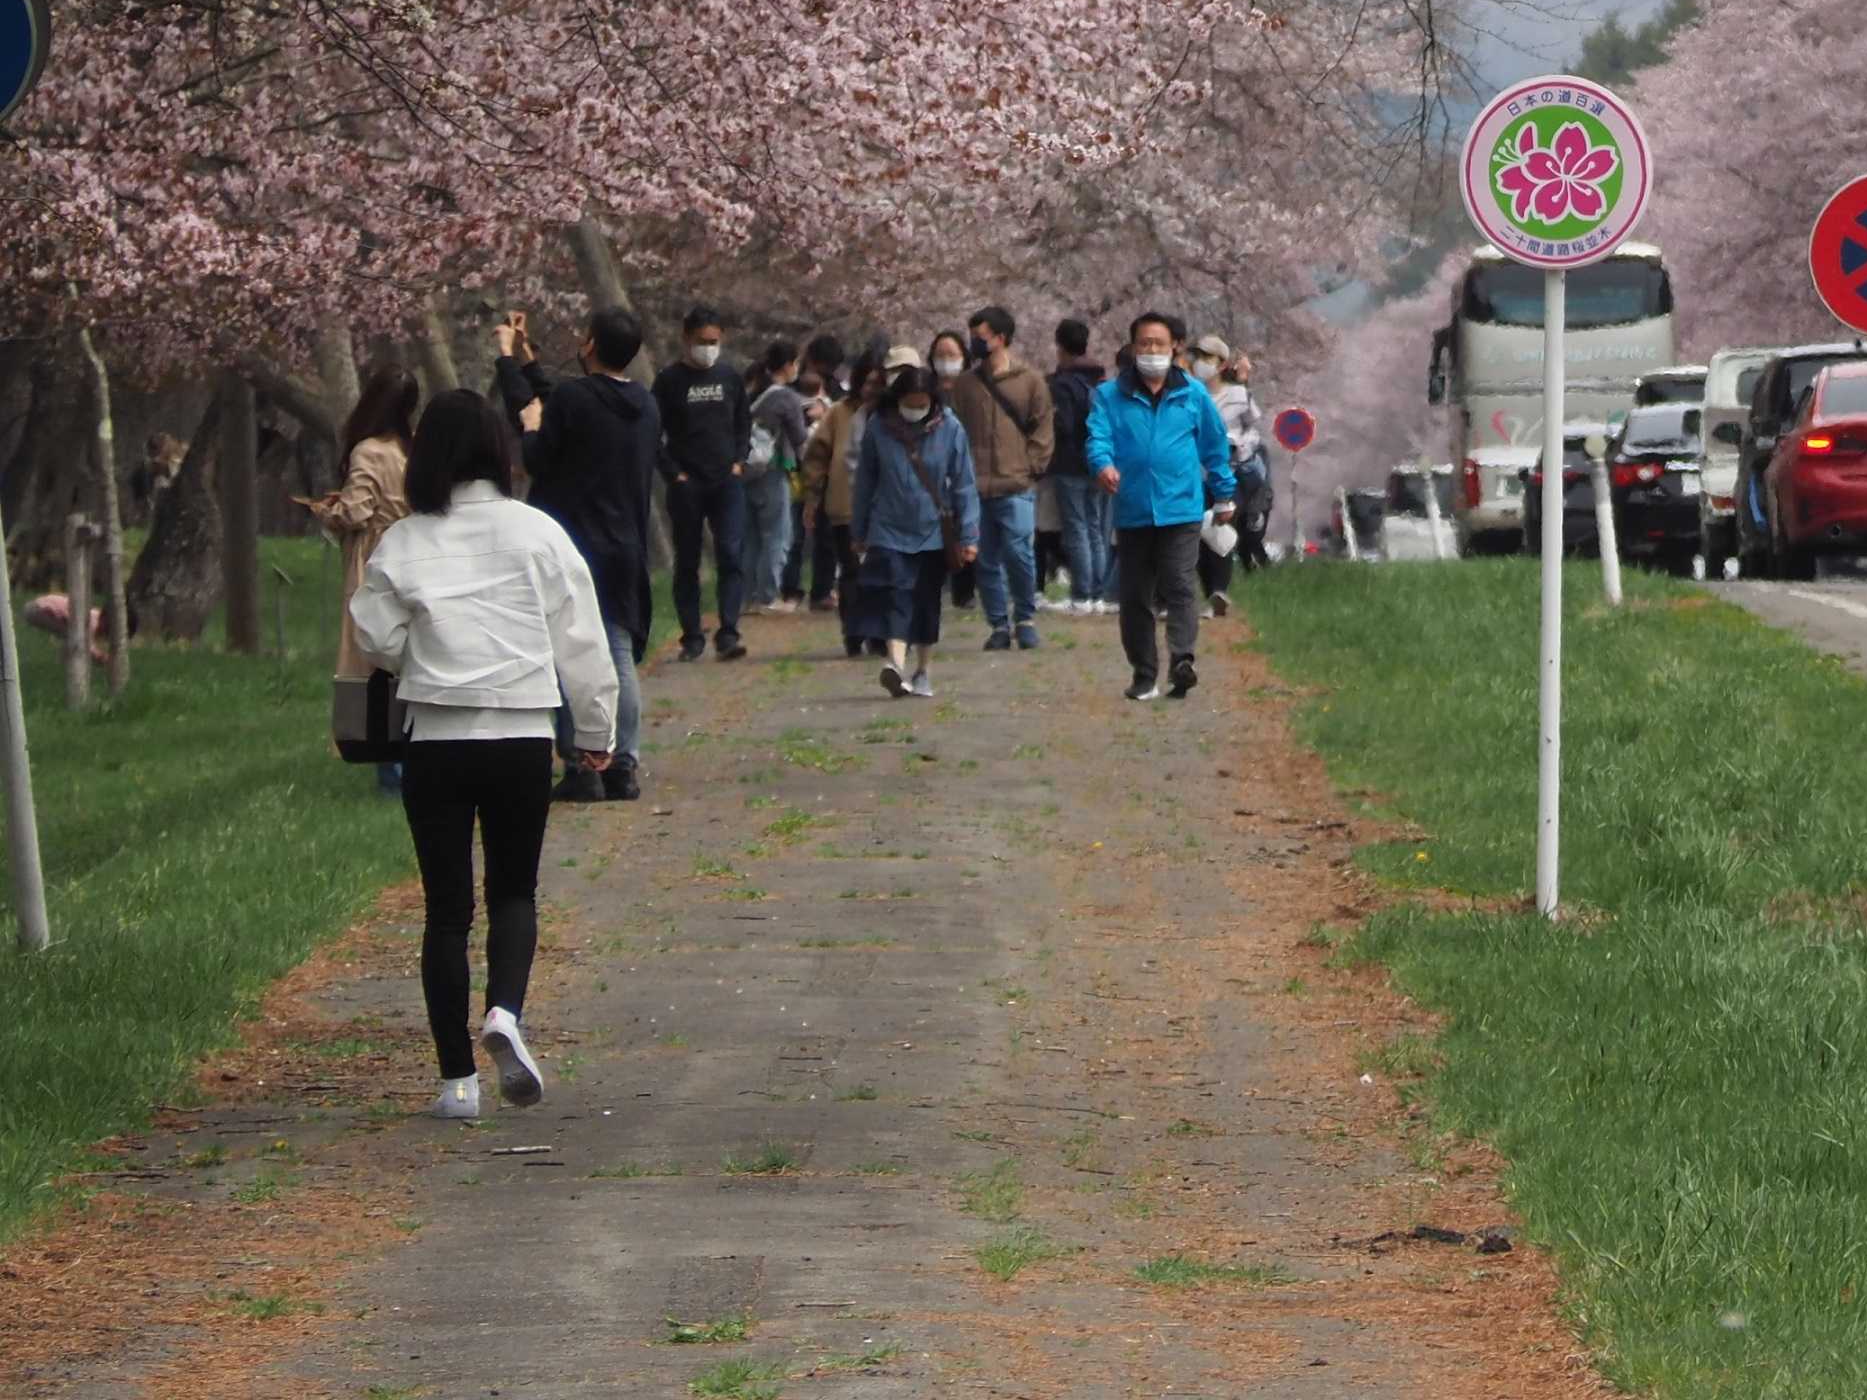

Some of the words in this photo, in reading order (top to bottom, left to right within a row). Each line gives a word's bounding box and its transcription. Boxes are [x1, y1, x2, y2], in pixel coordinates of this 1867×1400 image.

[1507, 90, 1605, 116] 日本の道百選
[687, 384, 723, 397] AIGLE
